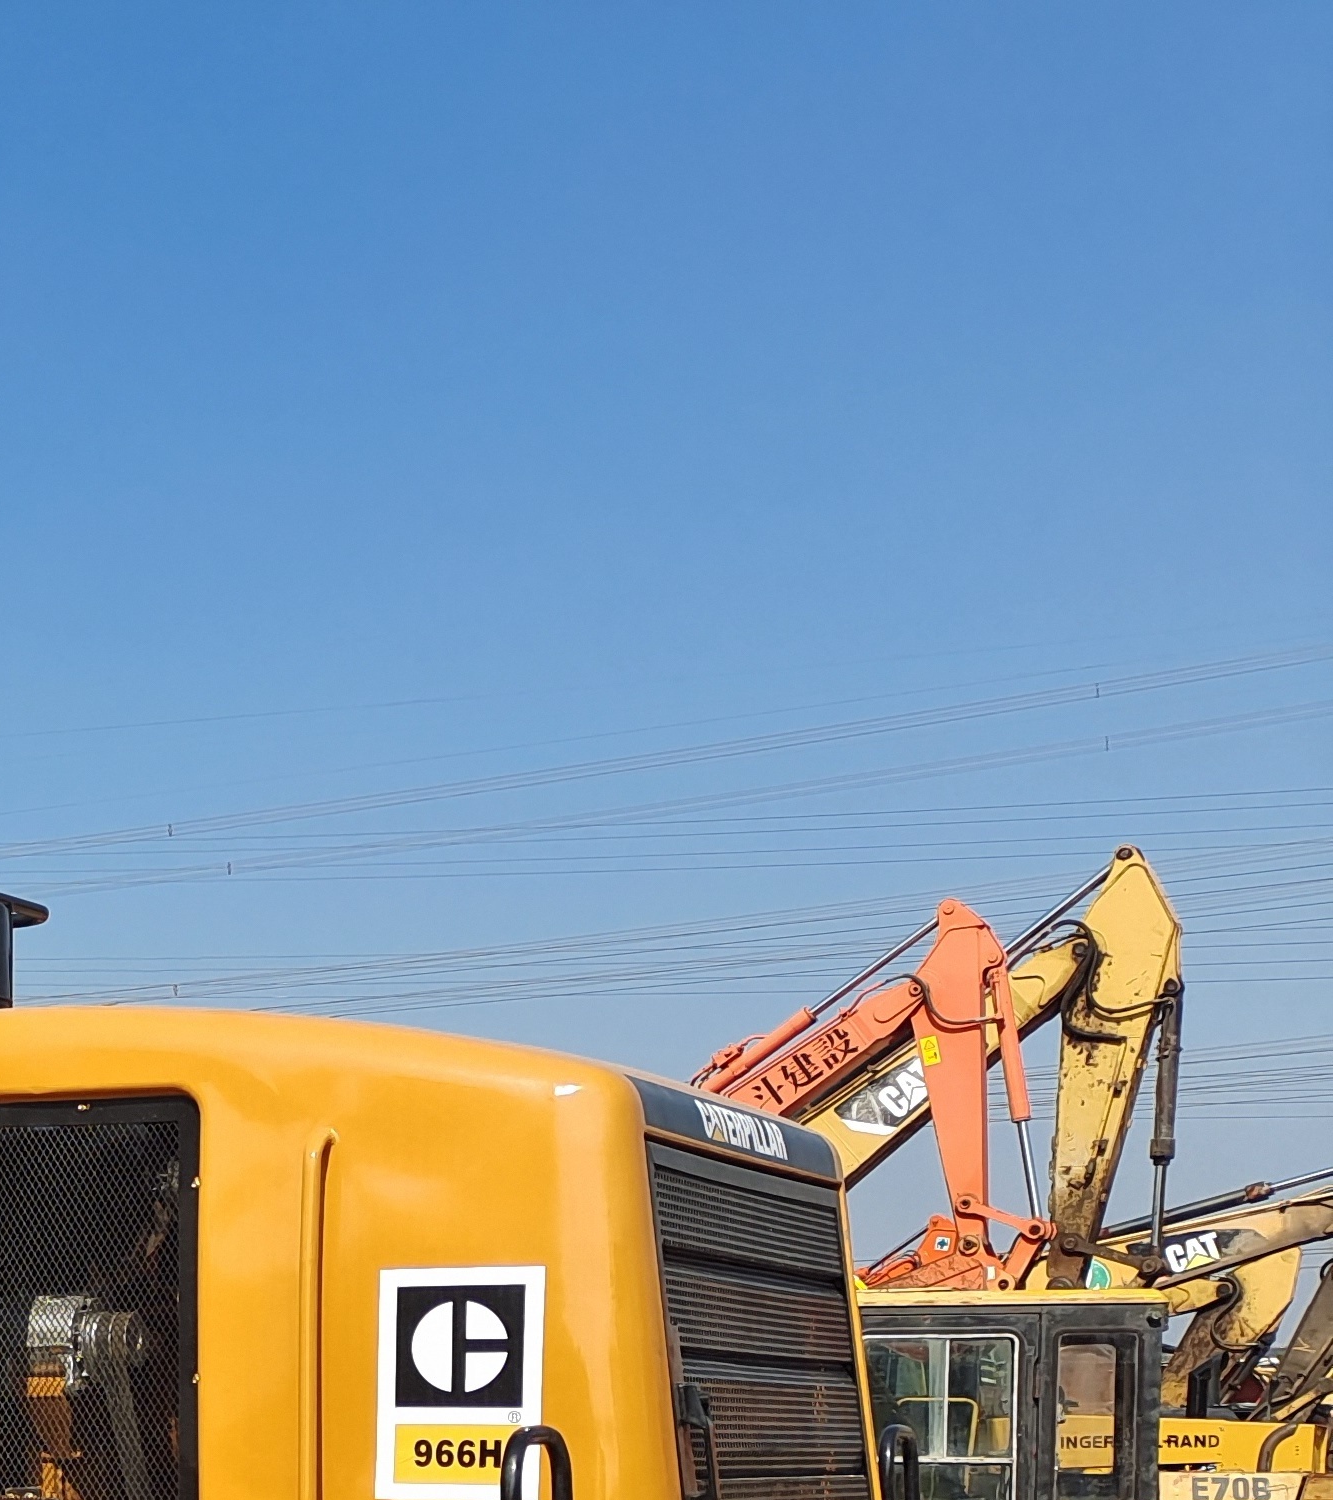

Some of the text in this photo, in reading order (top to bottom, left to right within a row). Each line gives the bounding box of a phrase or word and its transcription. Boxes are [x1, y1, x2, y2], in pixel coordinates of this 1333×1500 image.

[694, 1099, 789, 1161] CATERPILLAR
[1165, 1231, 1221, 1273] CAT
[414, 1439, 502, 1469] 966H
